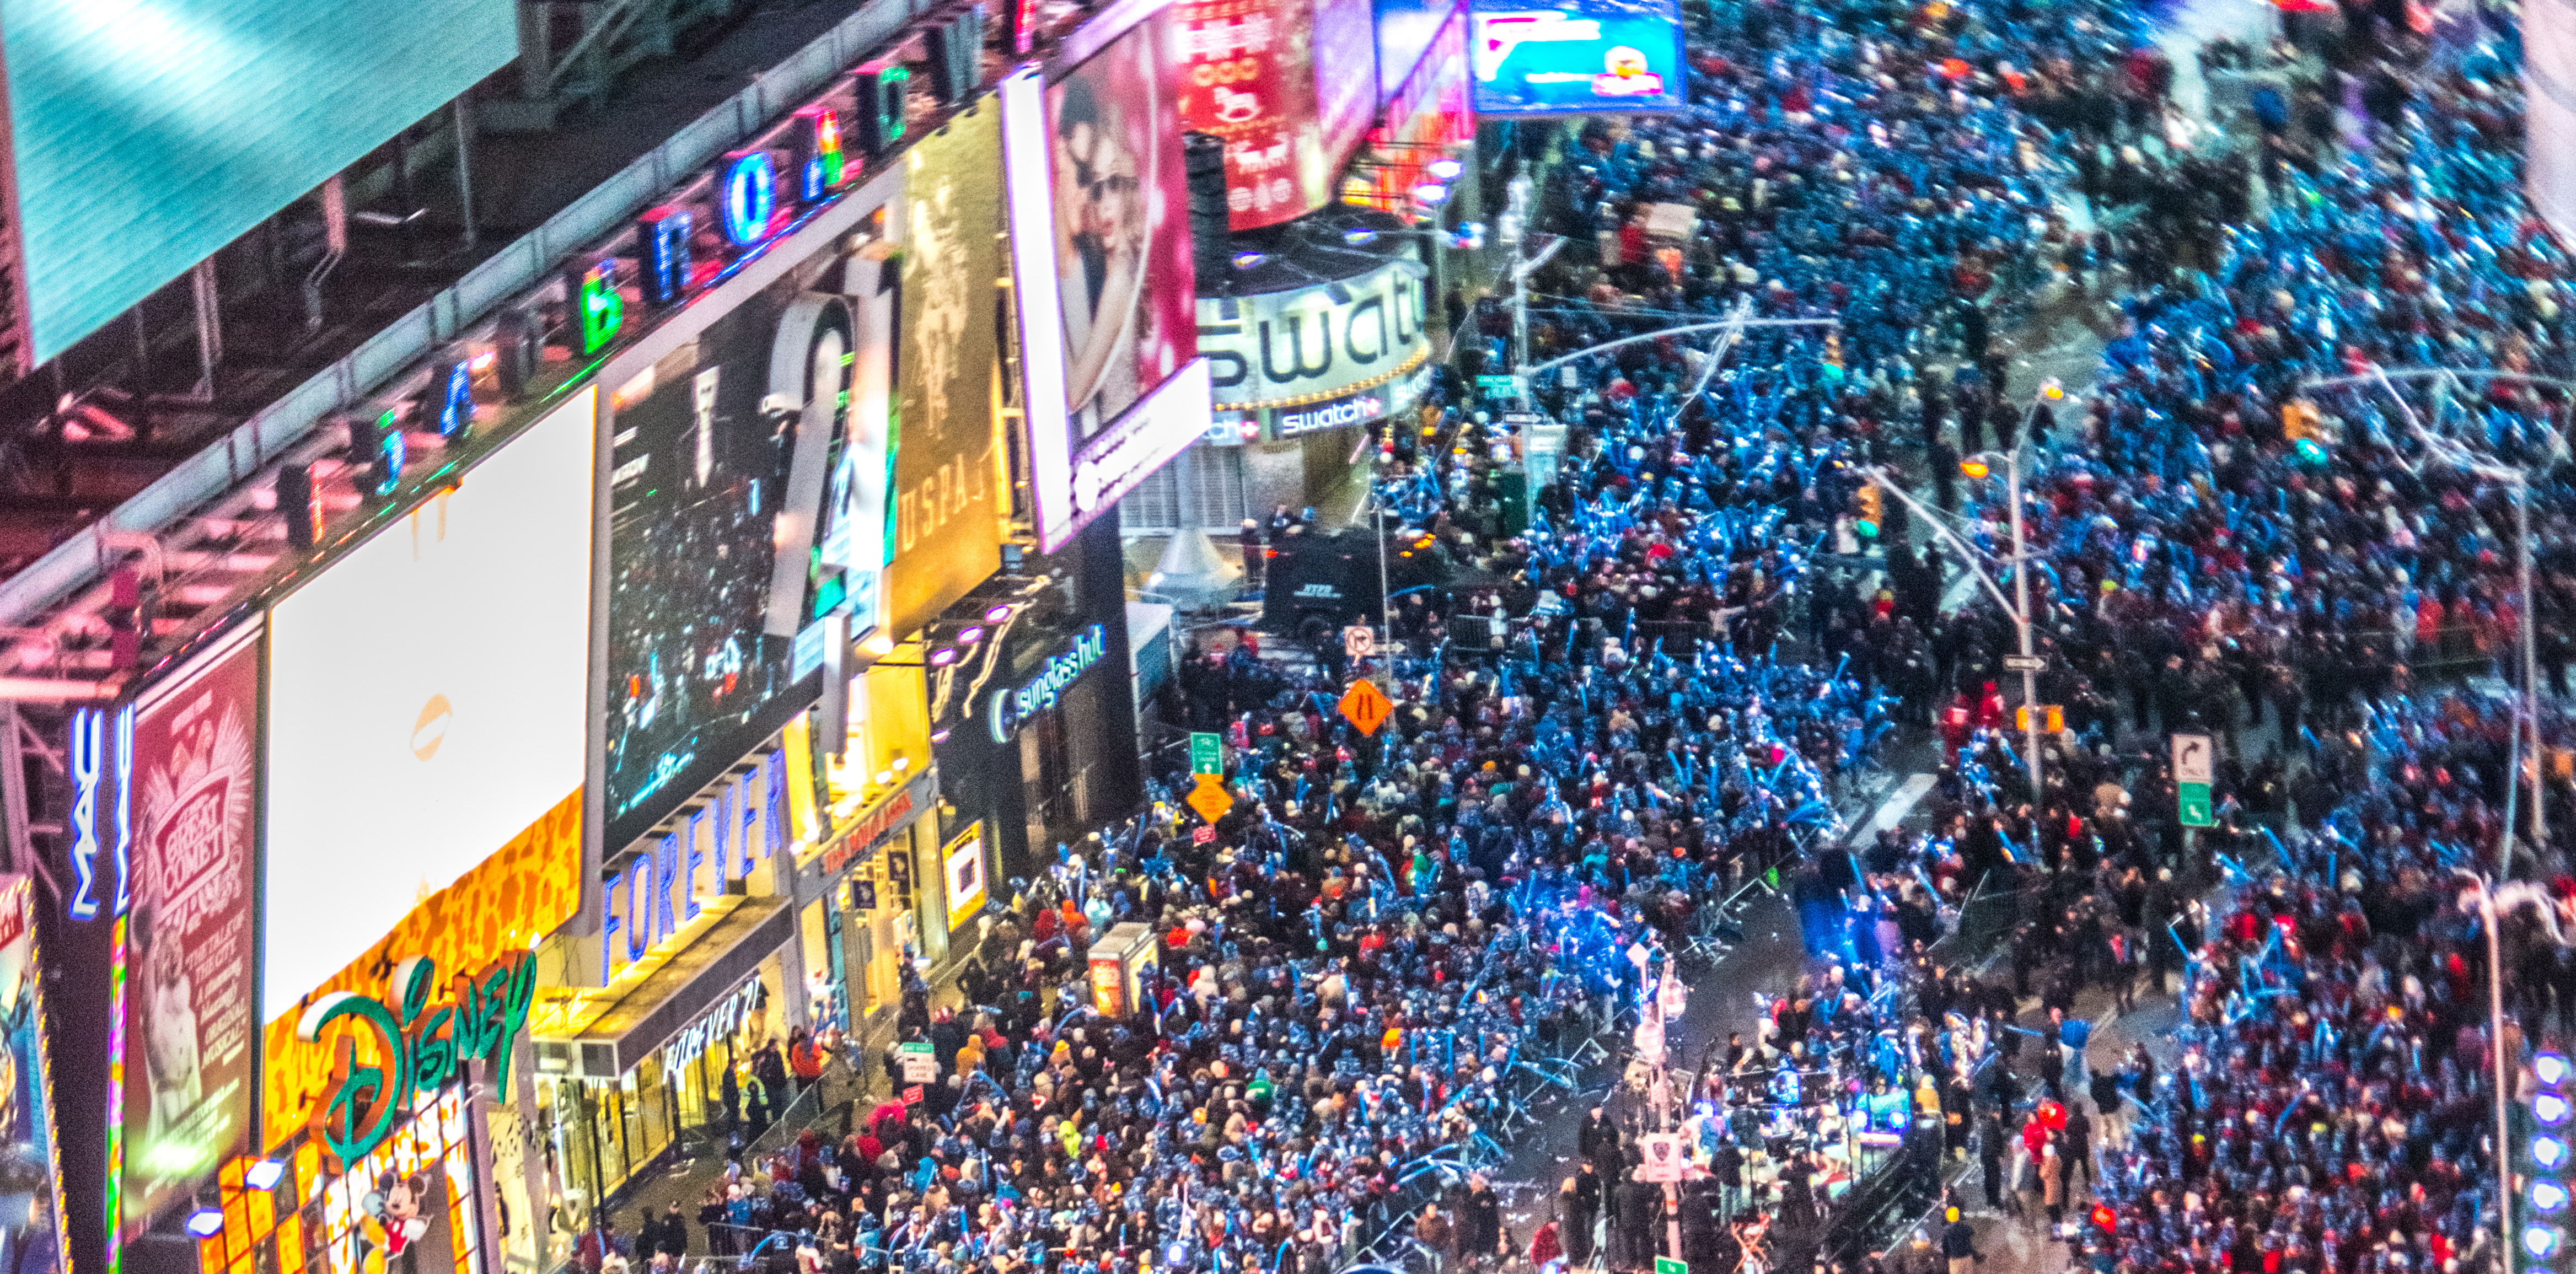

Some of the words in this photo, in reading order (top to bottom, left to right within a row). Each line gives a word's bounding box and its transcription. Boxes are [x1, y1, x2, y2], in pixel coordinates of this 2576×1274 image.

[1283, 398, 1367, 434] swatch
[1018, 652, 1078, 717] sunglass
[1077, 625, 1104, 669] hut
[164, 824, 221, 899] COMET
[165, 793, 221, 864] GREAT
[602, 749, 785, 987] FOREVER
[662, 993, 738, 1084] FOREVER
